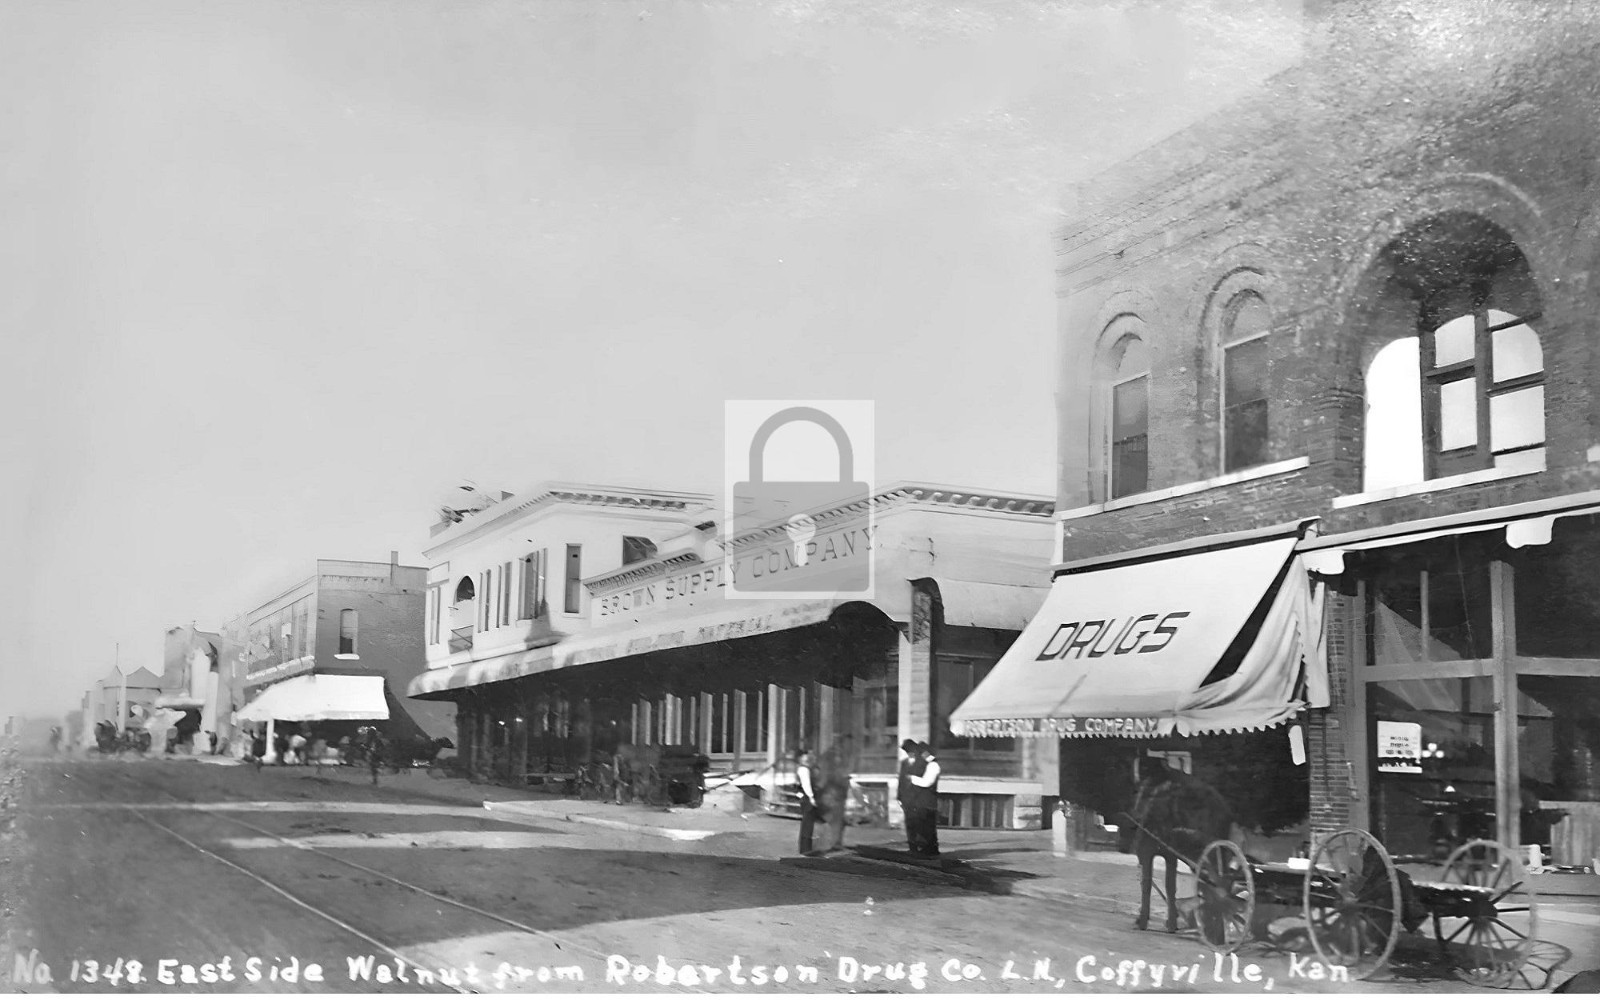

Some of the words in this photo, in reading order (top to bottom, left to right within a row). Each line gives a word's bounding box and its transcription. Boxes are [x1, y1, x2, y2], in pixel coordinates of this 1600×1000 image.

[600, 584, 656, 617] BRON
[665, 564, 738, 600] SUPPLY
[752, 524, 879, 579] COMPANY
[1034, 610, 1191, 662] DRUGS
[1084, 717, 1158, 734] COMPANY
